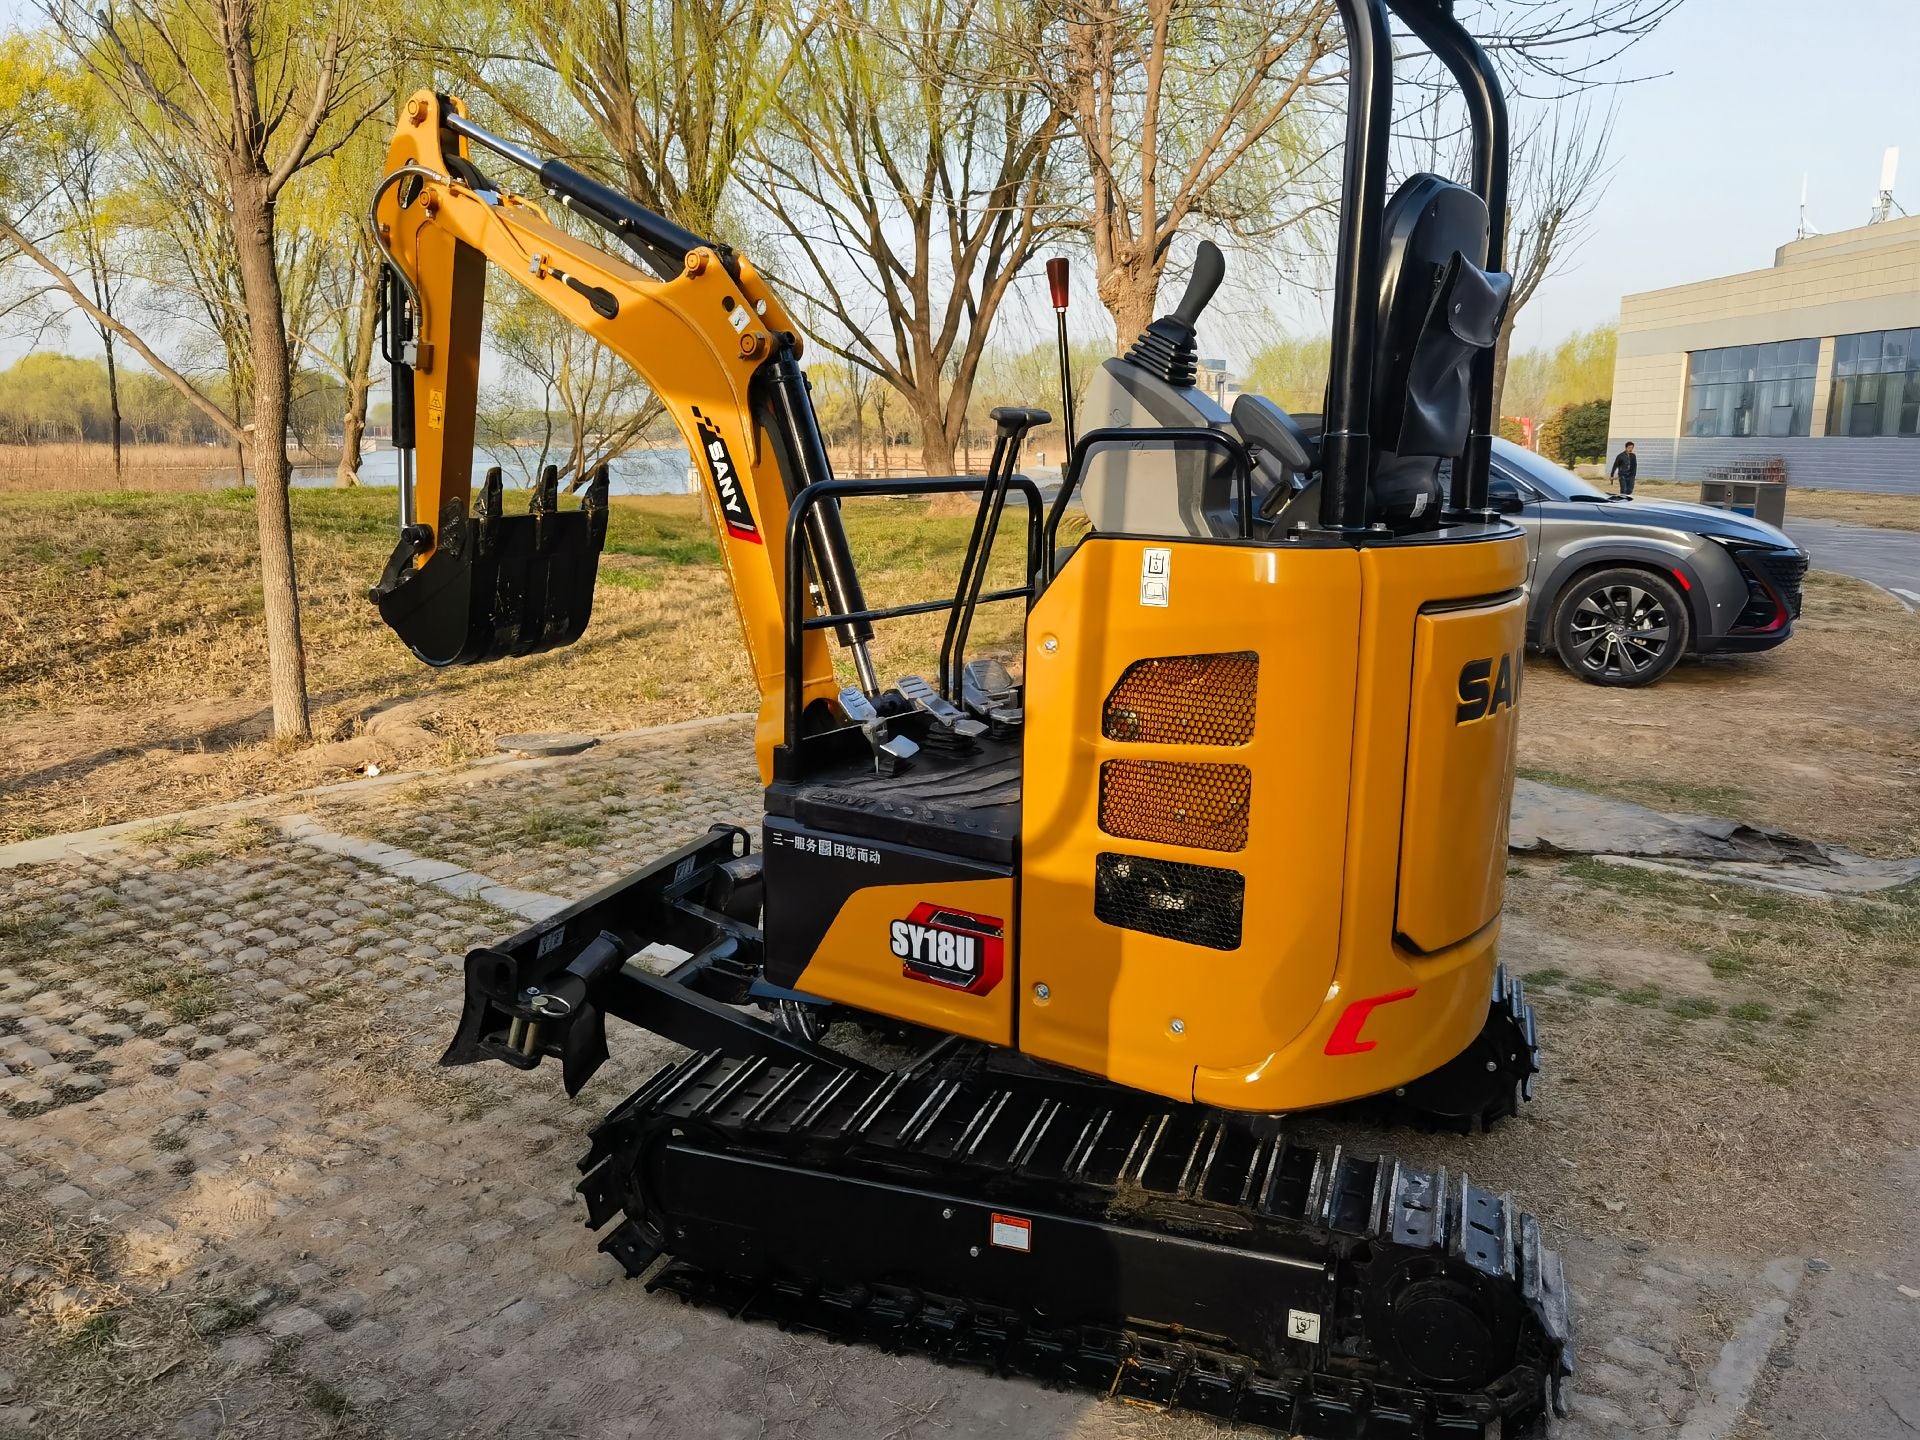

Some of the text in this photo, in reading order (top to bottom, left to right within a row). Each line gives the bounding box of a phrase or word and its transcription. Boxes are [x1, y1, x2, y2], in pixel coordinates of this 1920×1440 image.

[708, 440, 742, 513] SANY
[773, 832, 881, 865] 三一服务 因您而动
[892, 921, 975, 971] SY18U
